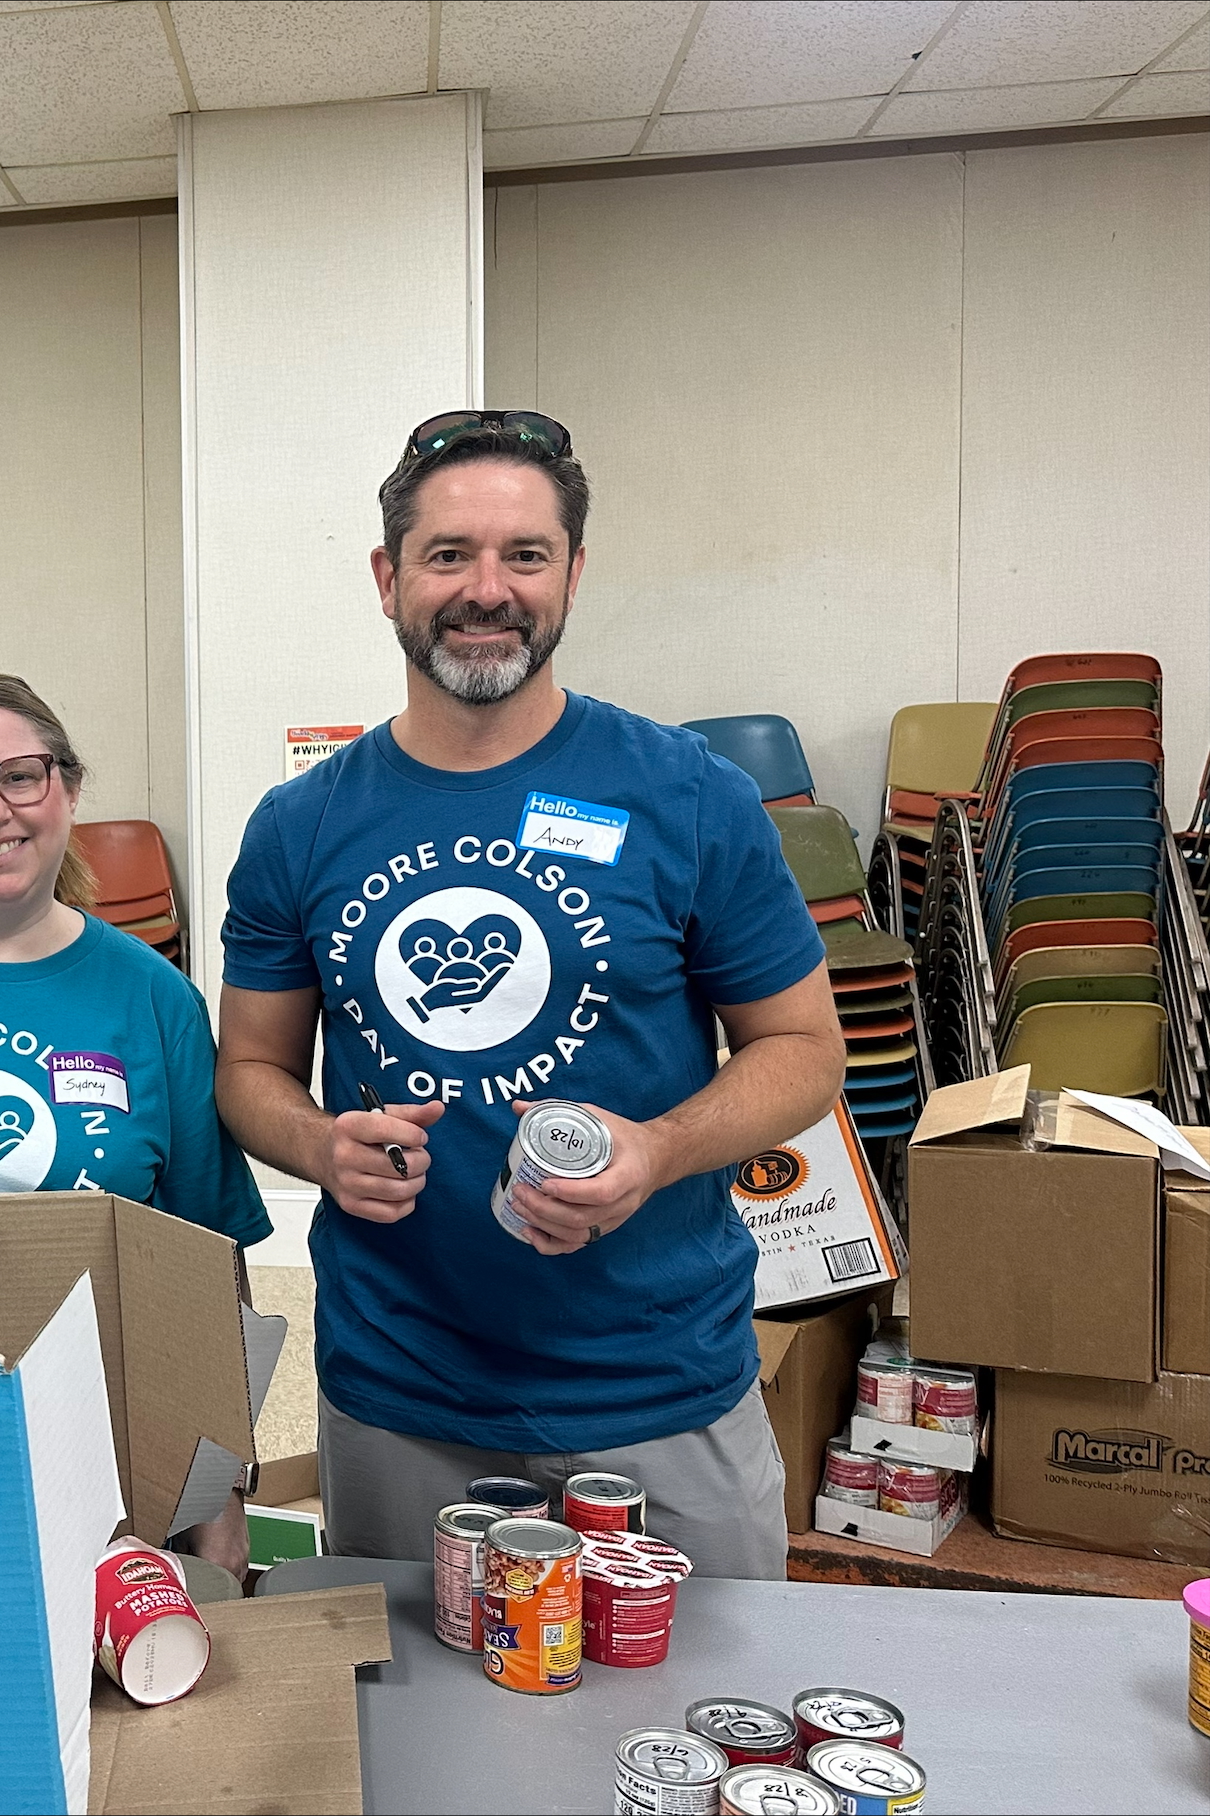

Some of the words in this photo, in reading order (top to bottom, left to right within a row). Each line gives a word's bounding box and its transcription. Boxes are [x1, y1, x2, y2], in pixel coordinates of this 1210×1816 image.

[293, 744, 347, 755] #WHYIG
[530, 796, 578, 817] Hello
[590, 815, 611, 824] name
[533, 826, 584, 850] ANDY
[328, 841, 439, 963] MOORE
[453, 836, 612, 949] COLSON
[343, 998, 399, 1070] DAY
[407, 1071, 464, 1104] OF
[480, 983, 610, 1105] IMPACT
[53, 1056, 95, 1070] Hello
[63, 1078, 106, 1097] Sydney
[758, 1224, 816, 1244] VODKA
[801, 1235, 836, 1248] TEXAS
[1053, 1428, 1163, 1472] Marcal
[1044, 1474, 1070, 1485] 100%
[1071, 1477, 1112, 1491] Recycled
[1114, 1483, 1138, 1496] 2-Ply
[1139, 1486, 1172, 1499] Jumbo
[121, 1566, 163, 1582] IDAHOAN
[114, 1587, 146, 1610] Buttery
[129, 1591, 184, 1611] MASHED
[134, 1598, 188, 1616] POTATOES
[628, 1776, 657, 1795] Facts
